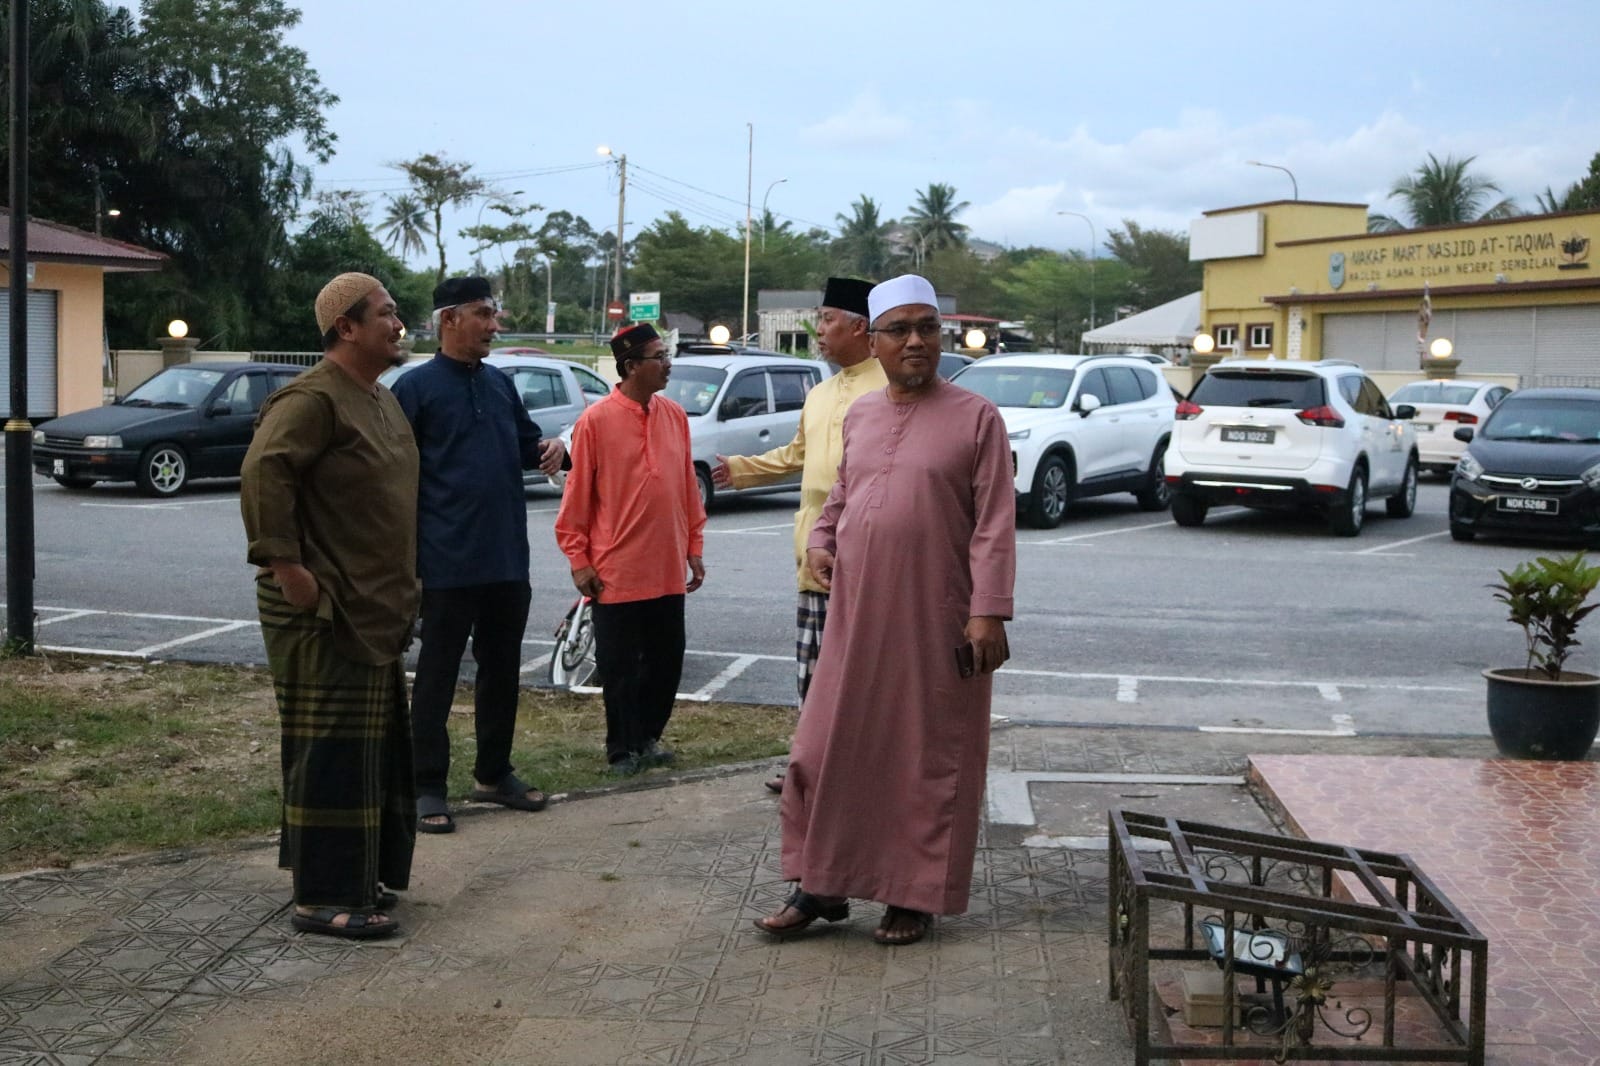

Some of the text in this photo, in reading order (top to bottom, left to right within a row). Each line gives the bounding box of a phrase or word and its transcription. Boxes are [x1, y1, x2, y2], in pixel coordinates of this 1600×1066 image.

[1352, 232, 1555, 264] WAKAF MART MASJID AT-TAQWA
[1421, 265, 1450, 277] ISLAM
[1501, 257, 1555, 270] SEMBILAN
